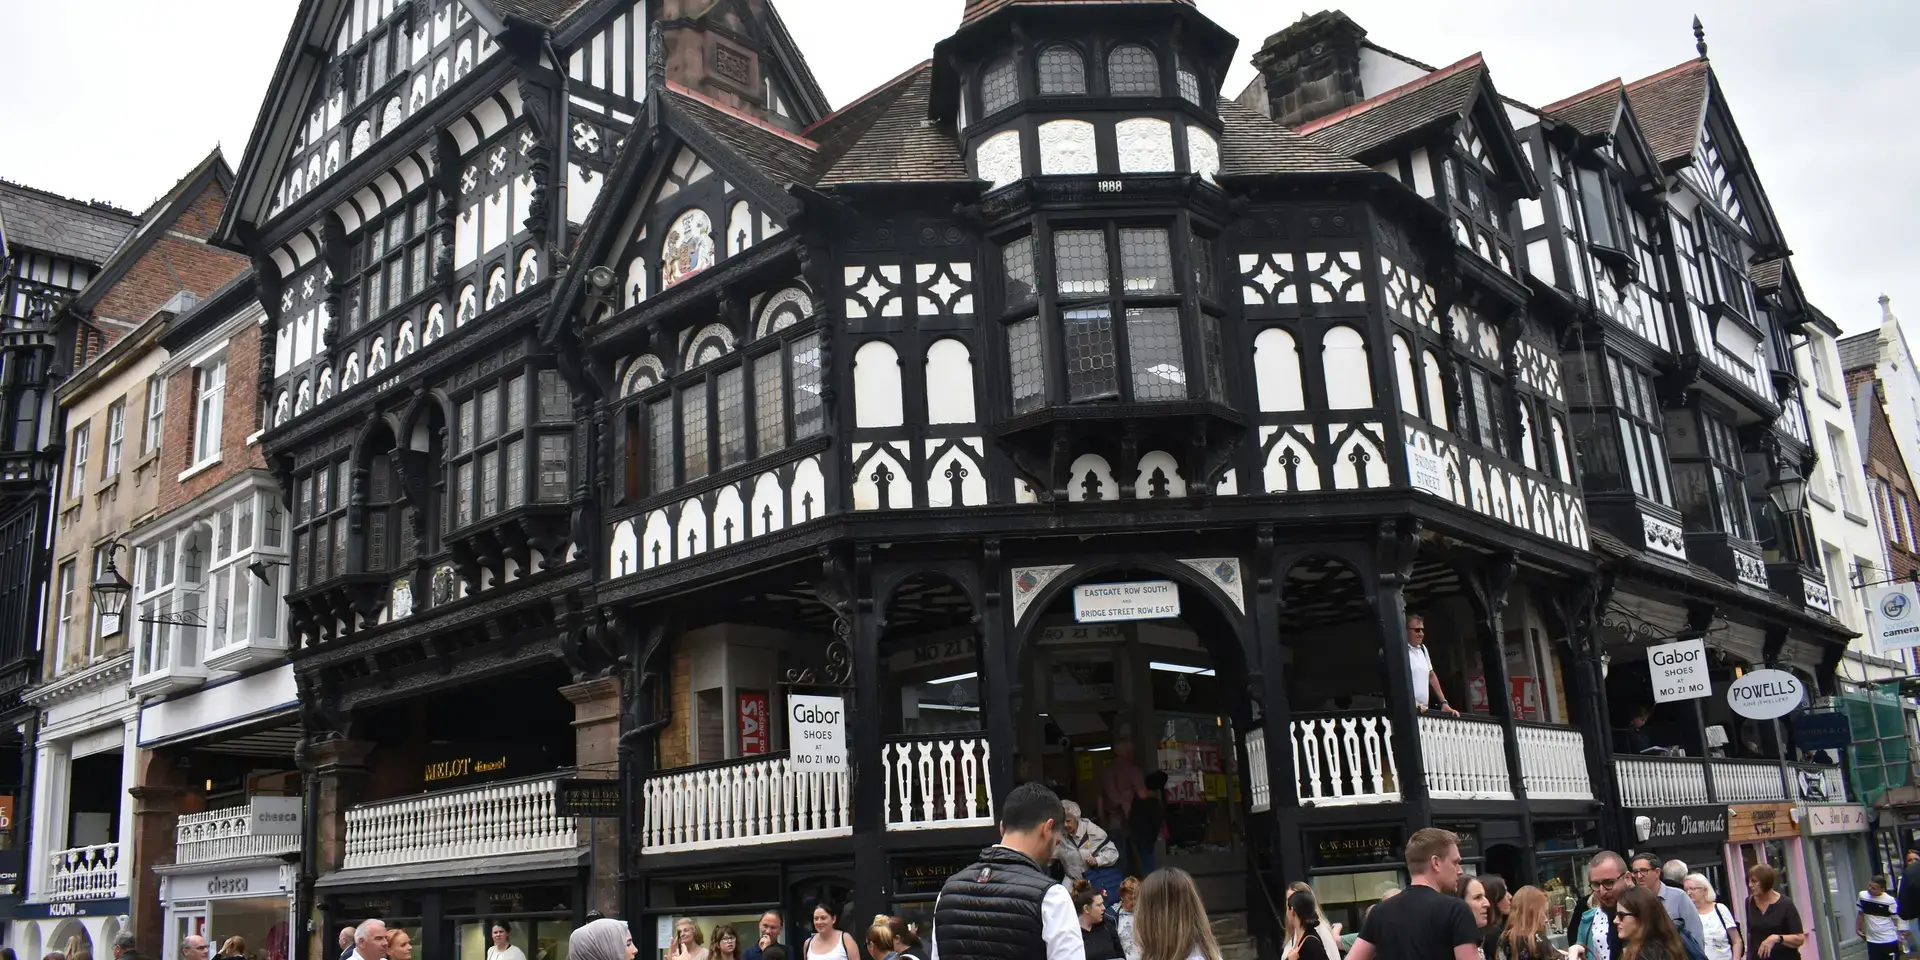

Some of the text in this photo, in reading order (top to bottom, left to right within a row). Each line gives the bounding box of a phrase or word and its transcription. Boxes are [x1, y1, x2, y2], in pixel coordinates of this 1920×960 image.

[1098, 180, 1122, 192] 1888
[1414, 453, 1438, 474] BRIDGE
[1416, 470, 1441, 491] STREET
[1084, 585, 1168, 597] EASTGATE ROW SOUTH
[1081, 605, 1174, 618] BRIDGE STREET ROW EAST
[1883, 626, 1919, 638] camera
[1653, 649, 1700, 666] Gabor
[1665, 667, 1694, 677] SHOES
[1660, 684, 1704, 697] MO ZI MO
[1733, 679, 1796, 702] POWELLS
[1757, 696, 1789, 707] JEWELLERY
[793, 704, 840, 725] Gabor
[803, 730, 832, 740] SHOES
[797, 755, 840, 764] MO ZI MO
[424, 757, 471, 781] MELOT
[258, 811, 297, 822] chesca
[1681, 813, 1725, 835] Diamonds
[207, 876, 249, 894] chesca
[50, 903, 76, 916] KUONI
